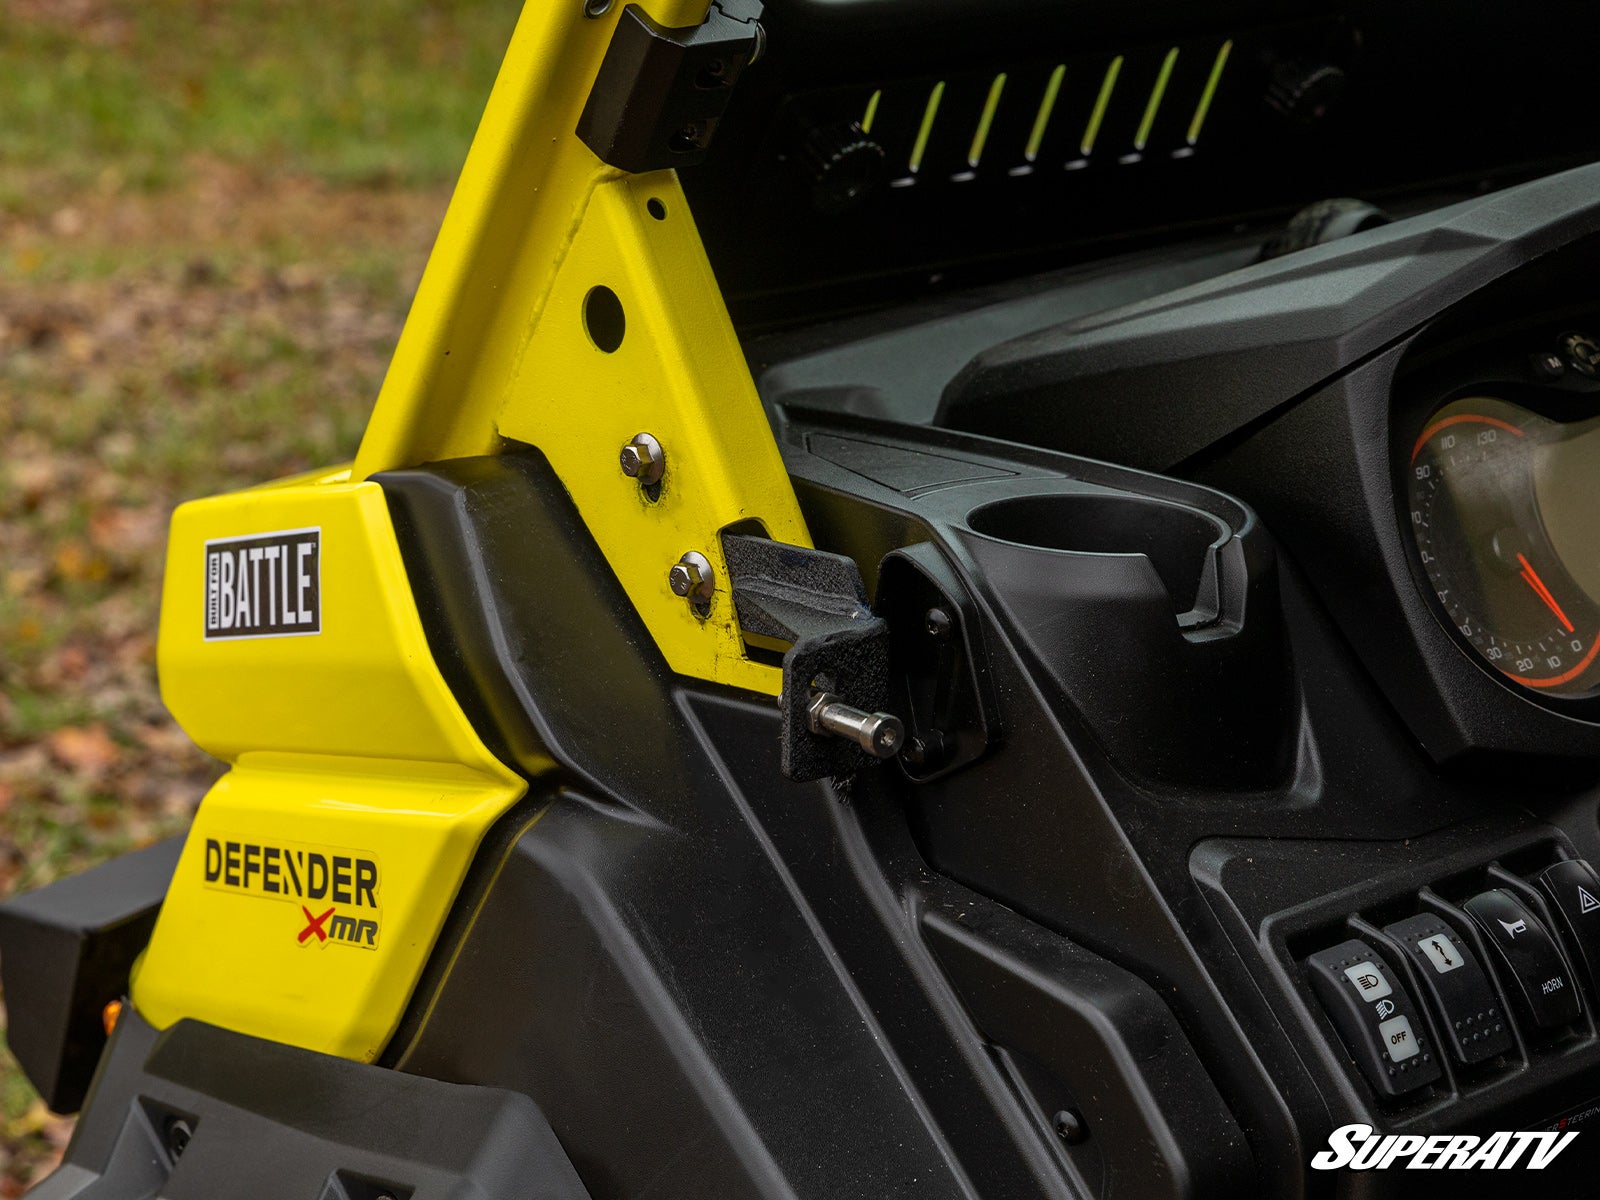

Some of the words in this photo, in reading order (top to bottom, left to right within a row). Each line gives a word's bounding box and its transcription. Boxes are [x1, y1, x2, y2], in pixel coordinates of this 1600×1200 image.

[1441, 435, 1456, 450] 110
[1477, 429, 1497, 446] 130
[1415, 464, 1431, 480] 90
[220, 542, 313, 629] BATTLE
[1486, 646, 1503, 660] 30
[1571, 639, 1582, 652] 0
[1516, 657, 1534, 672] 20
[1547, 655, 1561, 669] 10
[205, 838, 378, 909] DEFENDER
[1541, 976, 1564, 995] HORN
[1390, 1030, 1408, 1046] OFF
